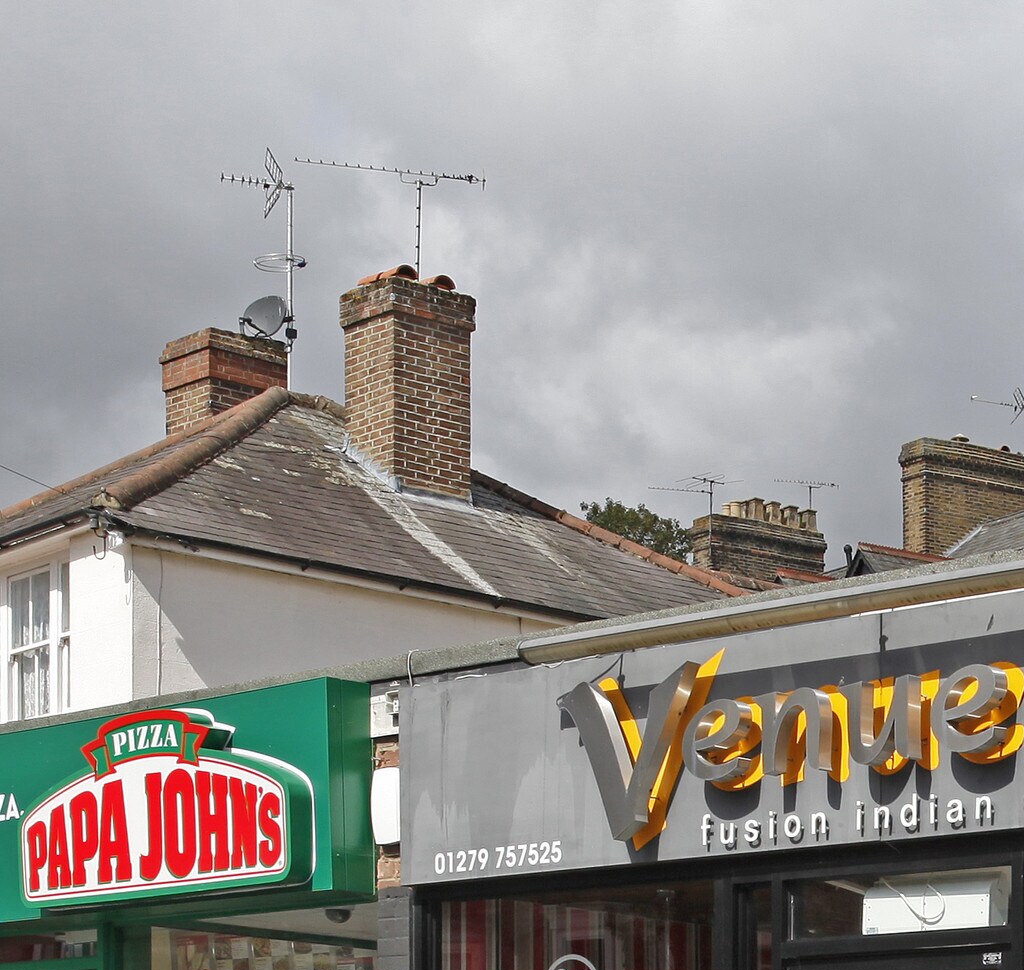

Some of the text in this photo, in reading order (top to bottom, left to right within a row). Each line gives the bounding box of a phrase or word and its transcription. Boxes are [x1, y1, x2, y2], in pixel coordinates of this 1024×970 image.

[111, 722, 179, 757] PIZZA
[556, 649, 1024, 849] Venue
[27, 768, 283, 892] PAPA JOHN'S
[700, 810, 828, 846] fusion
[857, 792, 992, 830] indian
[434, 840, 562, 875] 01279 757525
